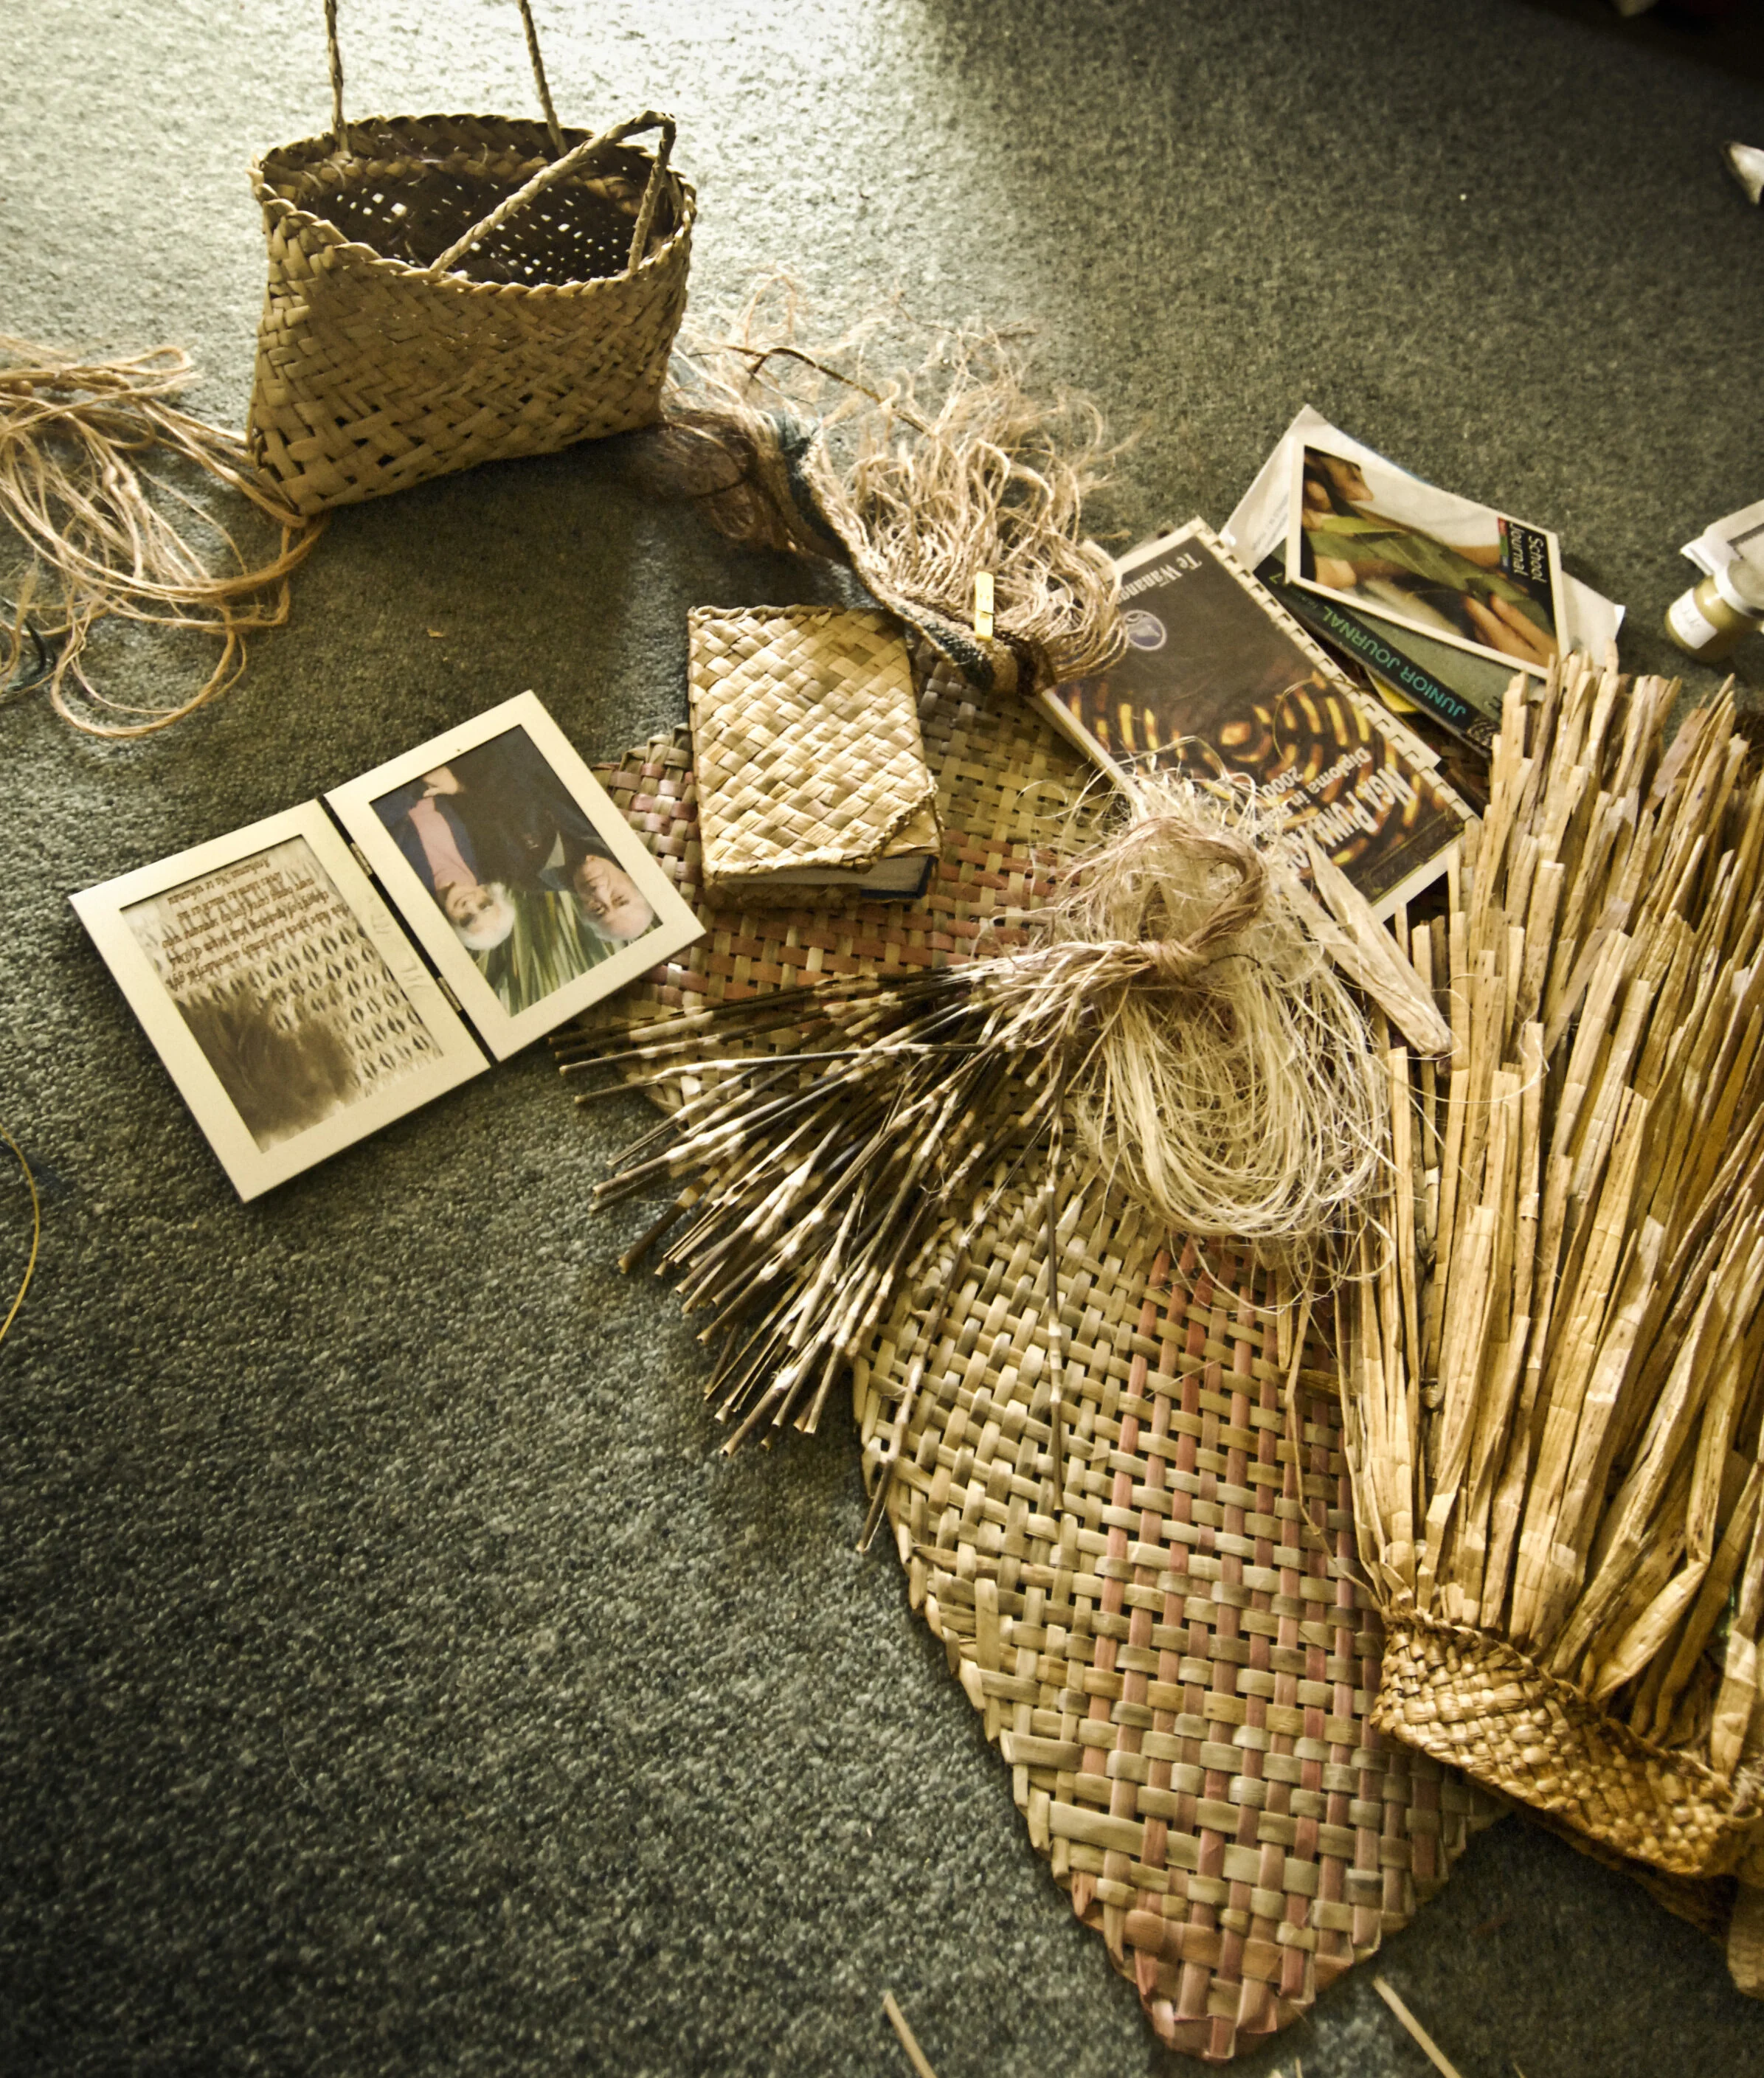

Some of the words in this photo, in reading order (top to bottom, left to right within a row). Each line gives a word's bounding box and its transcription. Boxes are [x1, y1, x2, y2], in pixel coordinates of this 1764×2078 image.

[1175, 552, 1202, 571] Te
[1509, 523, 1529, 575] Journal
[1527, 536, 1547, 582] School
[1321, 604, 1401, 672] JOURNAL
[1399, 664, 1467, 719] JUNIOR
[1260, 765, 1303, 800] 2000
[1305, 746, 1372, 794] Diploma
[1287, 791, 1310, 807] in
[1307, 790, 1380, 848] PUNA
